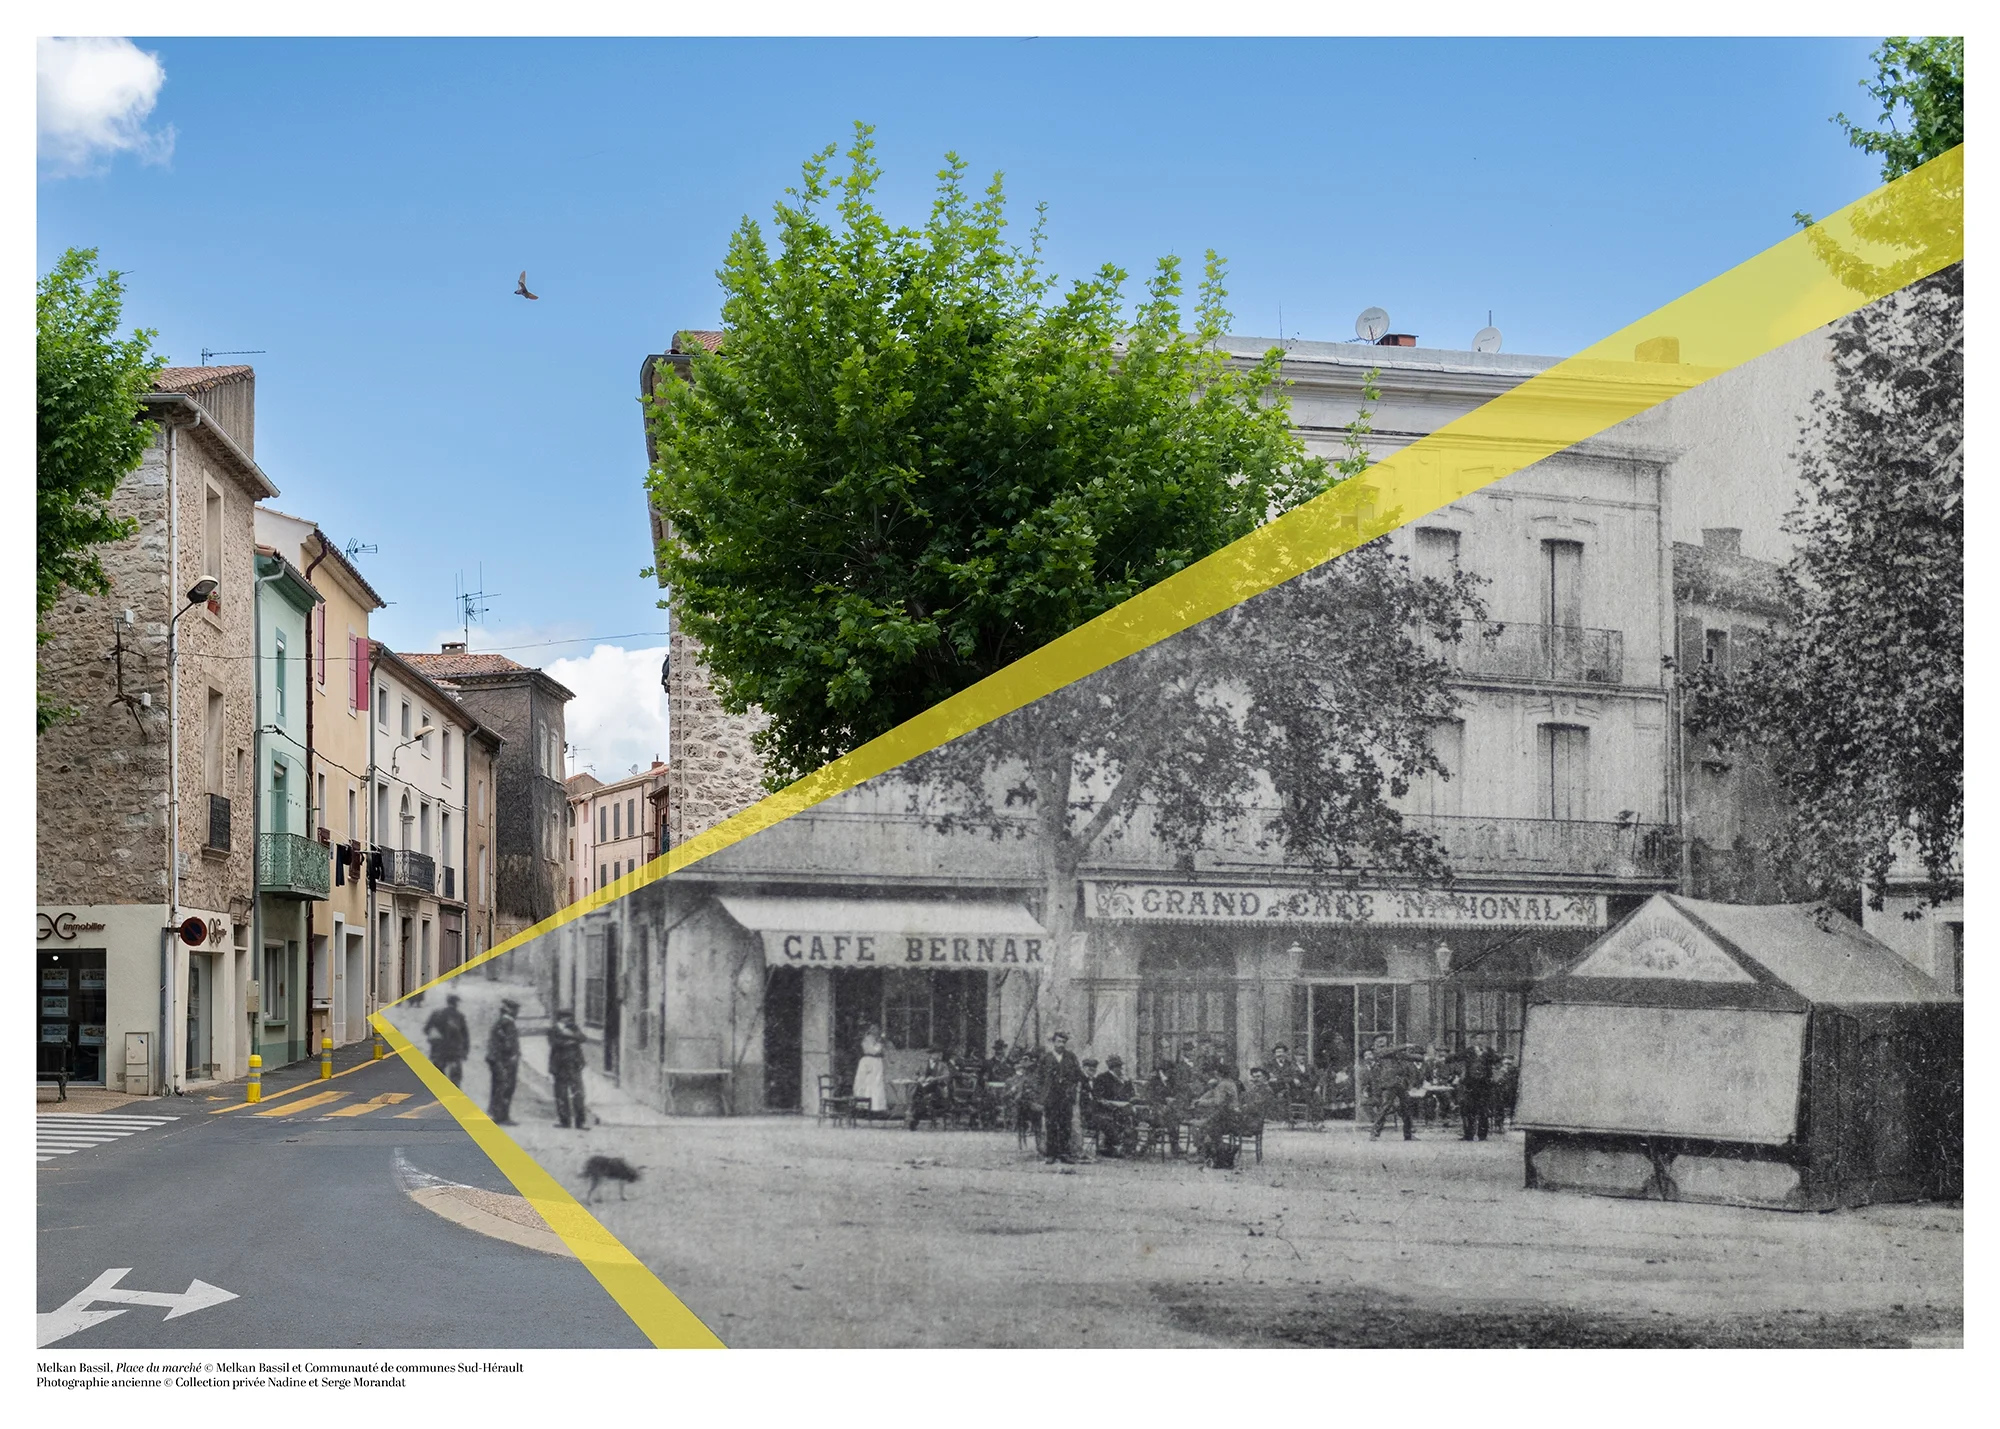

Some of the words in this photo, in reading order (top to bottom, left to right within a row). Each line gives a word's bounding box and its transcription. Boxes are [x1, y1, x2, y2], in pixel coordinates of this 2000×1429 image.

[1141, 888, 1260, 916] GRAND
[1401, 895, 1561, 921] NIONAL
[783, 935, 875, 961] CAFE
